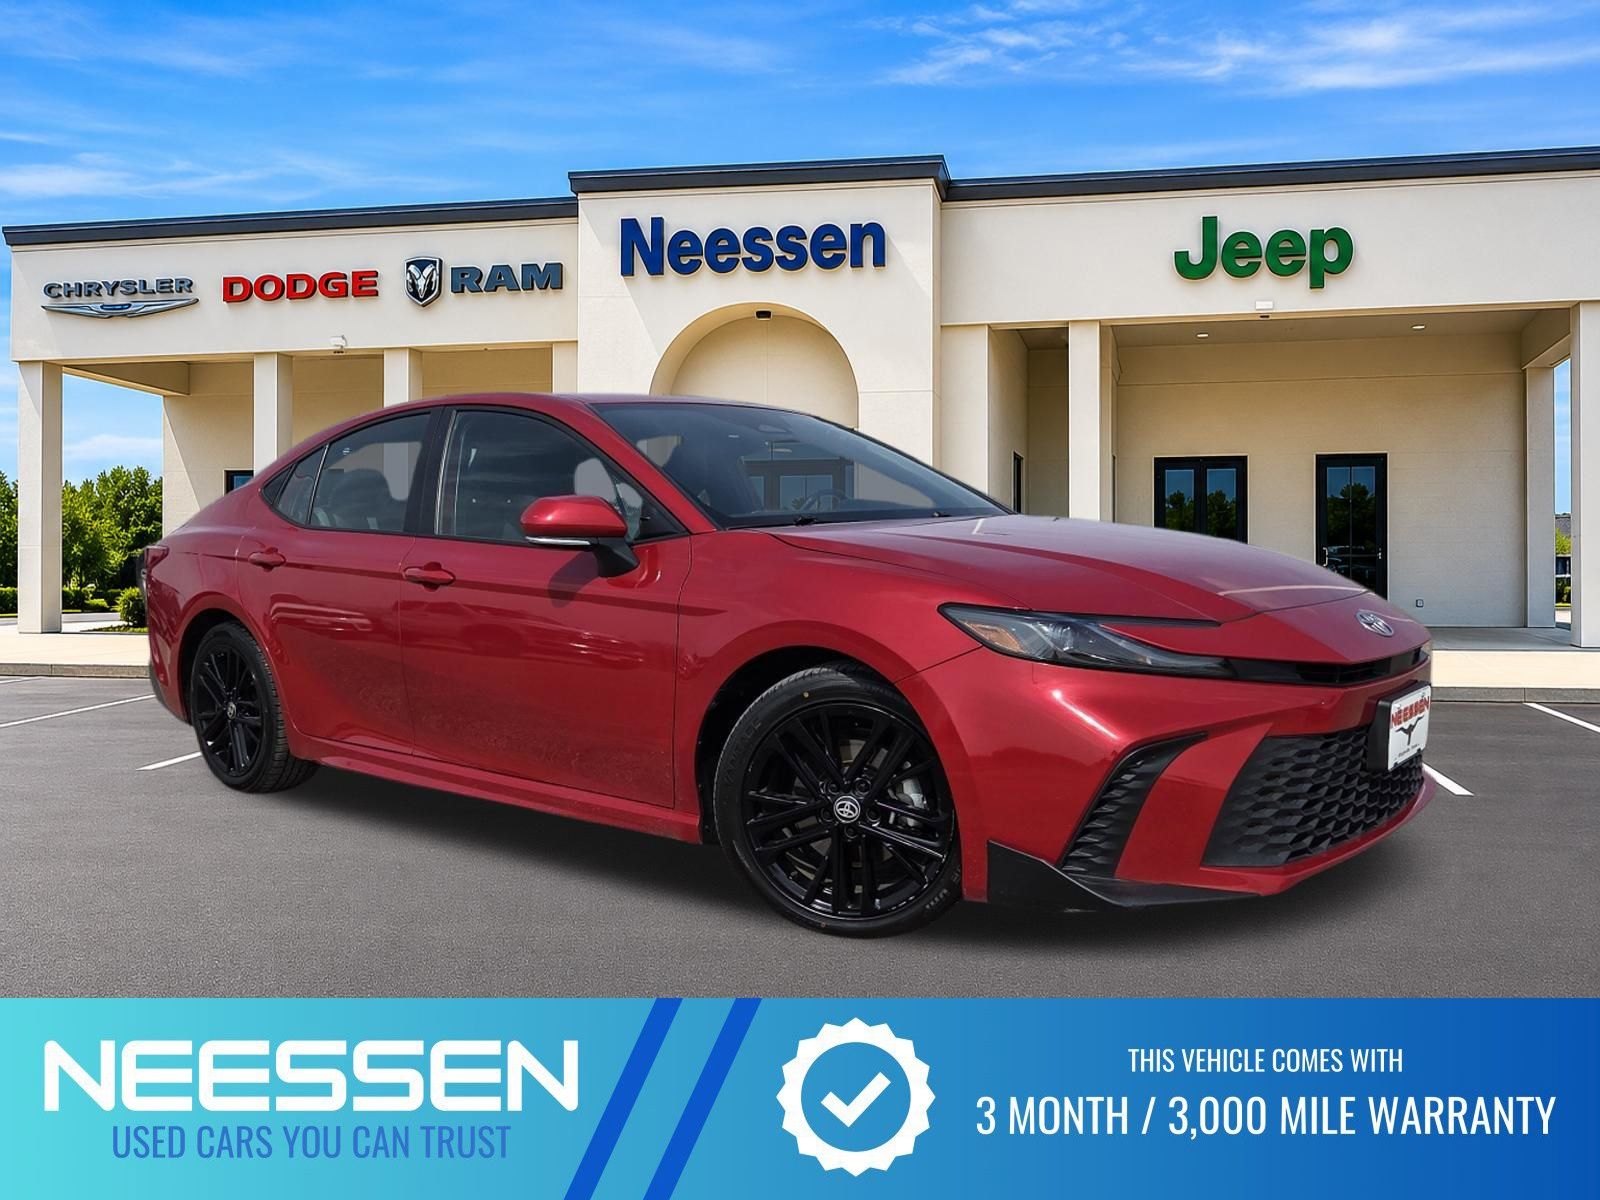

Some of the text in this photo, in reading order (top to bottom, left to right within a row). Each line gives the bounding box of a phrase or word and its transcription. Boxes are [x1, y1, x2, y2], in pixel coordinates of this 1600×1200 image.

[620, 216, 886, 277] Neessen
[1174, 216, 1353, 288] Jeep
[43, 278, 194, 299] CHRYSLER
[222, 270, 378, 303] DODGE
[450, 262, 563, 294] RAM
